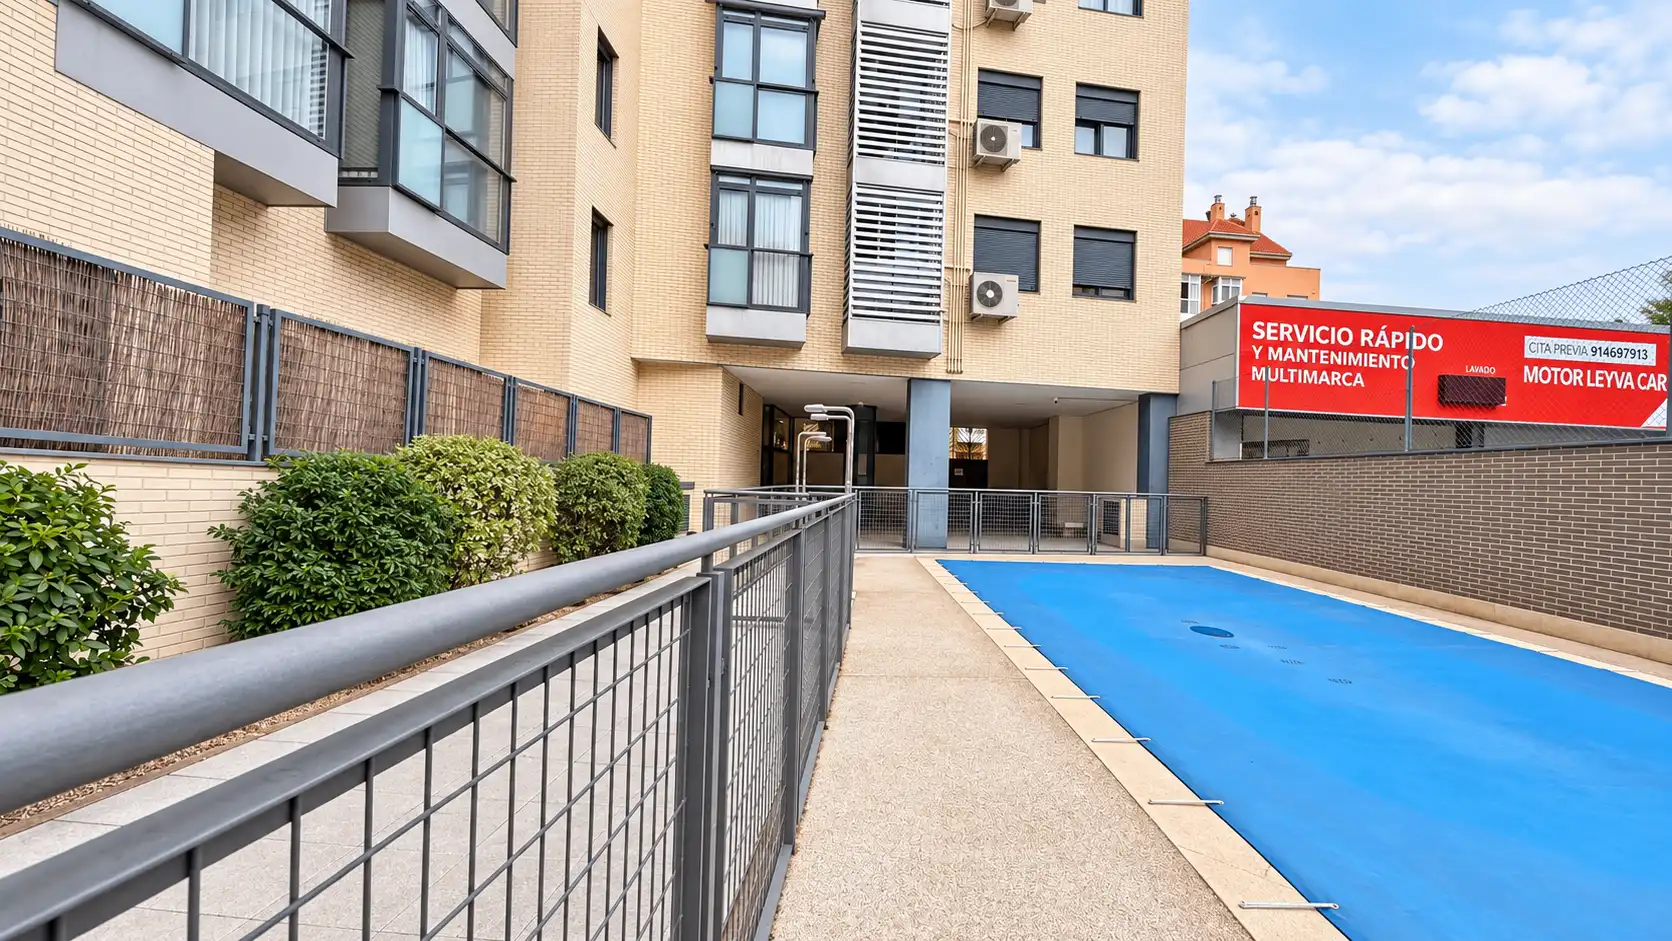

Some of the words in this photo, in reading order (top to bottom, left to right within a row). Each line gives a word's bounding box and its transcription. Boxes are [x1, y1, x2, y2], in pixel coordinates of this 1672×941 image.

[1252, 321, 1354, 347] SERVICIO
[1360, 325, 1444, 352] RÁPIDO
[1252, 345, 1264, 360] Y
[1267, 346, 1415, 370] MANTENIMIENTO
[1528, 341, 1551, 354] CITA
[1553, 343, 1589, 356] PREVIA
[1590, 346, 1649, 360] 914697913
[1251, 366, 1365, 388] MULTIMARCA
[1466, 365, 1496, 375] LAVADO
[1523, 365, 1584, 387] MOTOR
[1586, 369, 1636, 390] LEYVA
[1637, 373, 1668, 392] CAR
